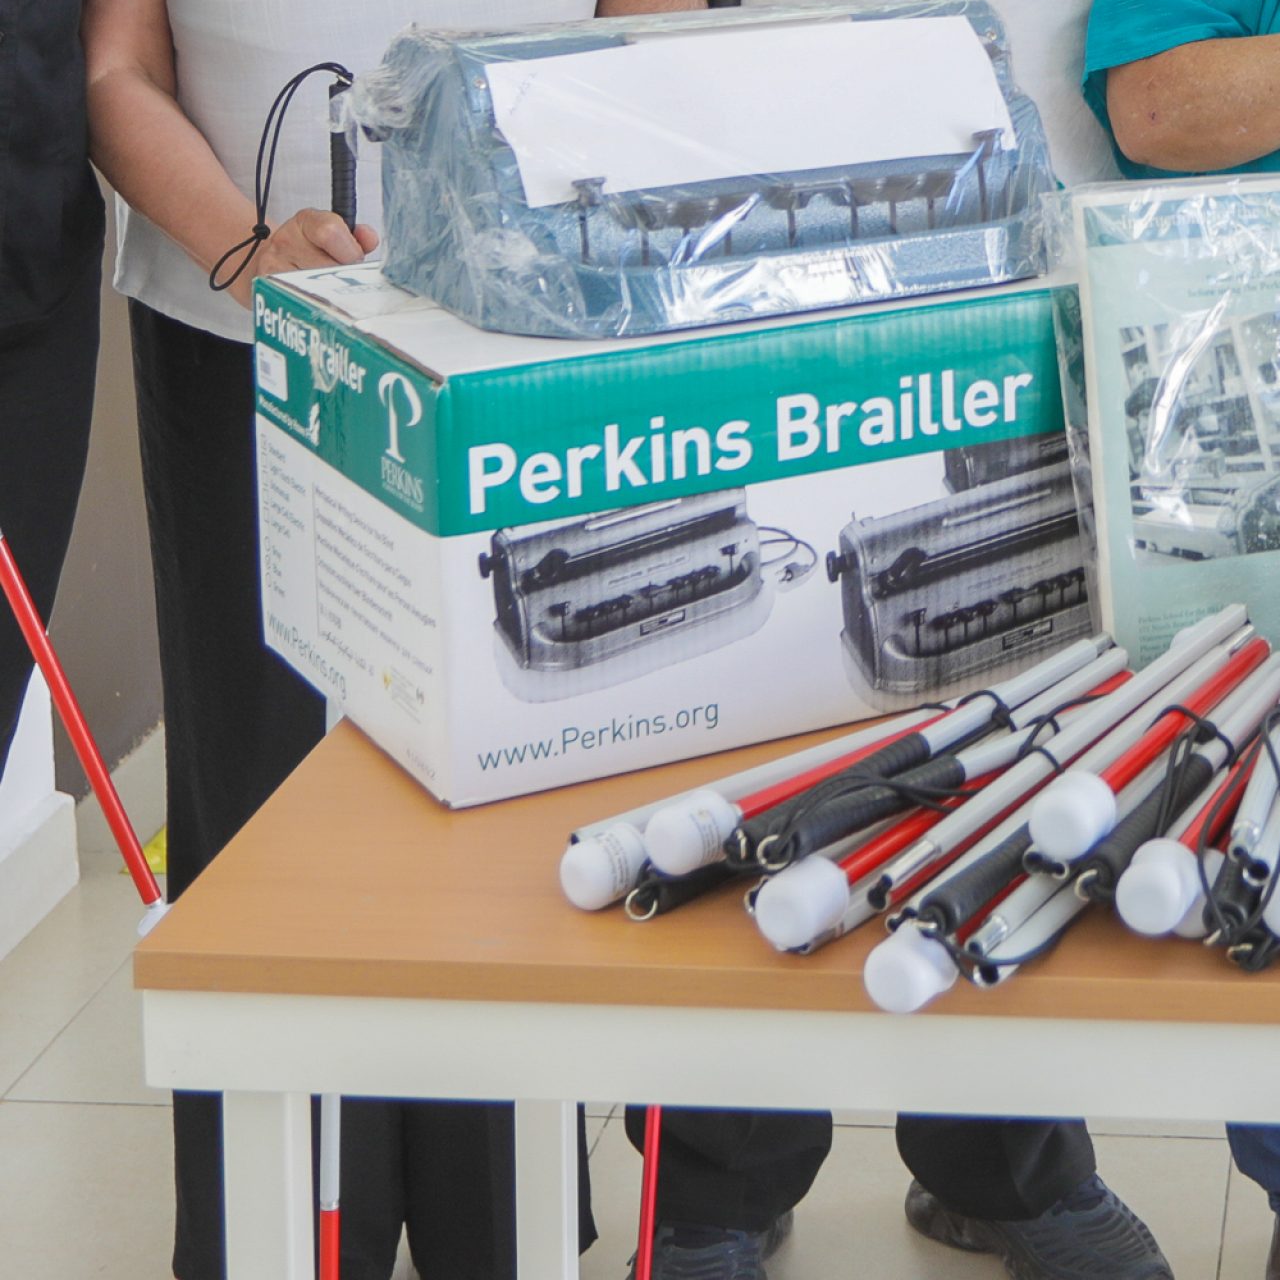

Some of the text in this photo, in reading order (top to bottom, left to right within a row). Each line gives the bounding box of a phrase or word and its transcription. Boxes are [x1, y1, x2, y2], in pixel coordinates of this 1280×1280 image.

[256, 293, 307, 356] Perkins
[468, 369, 1034, 515] Perkins Brailler
[381, 456, 424, 504] PERKINS
[478, 702, 719, 771] www.Perkins.org
